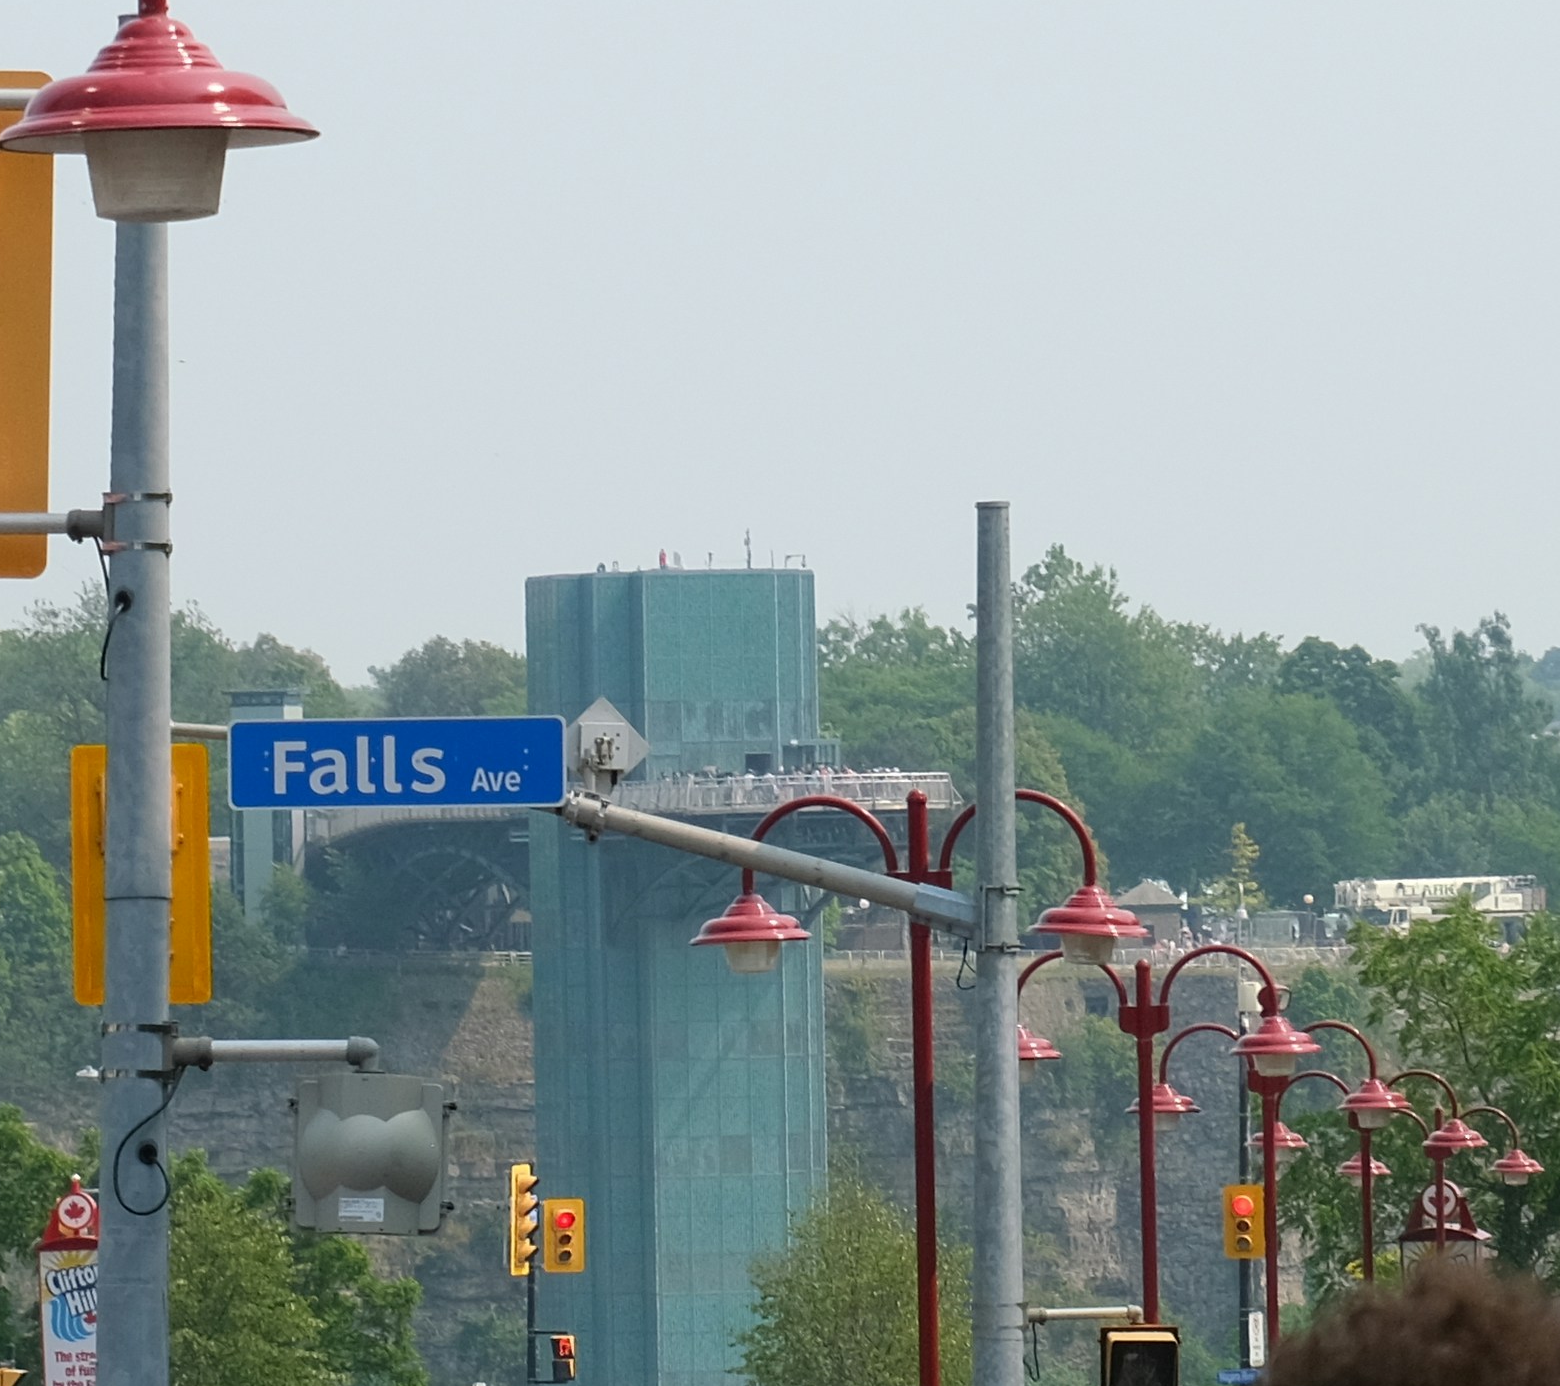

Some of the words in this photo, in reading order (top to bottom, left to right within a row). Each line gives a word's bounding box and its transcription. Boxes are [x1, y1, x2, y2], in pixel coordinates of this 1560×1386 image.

[272, 735, 446, 795] Falls
[471, 767, 521, 792] Ave
[47, 1265, 97, 1295] Clifto
[55, 1352, 72, 1362] The
[76, 1352, 96, 1362] stre
[65, 1365, 75, 1376] of
